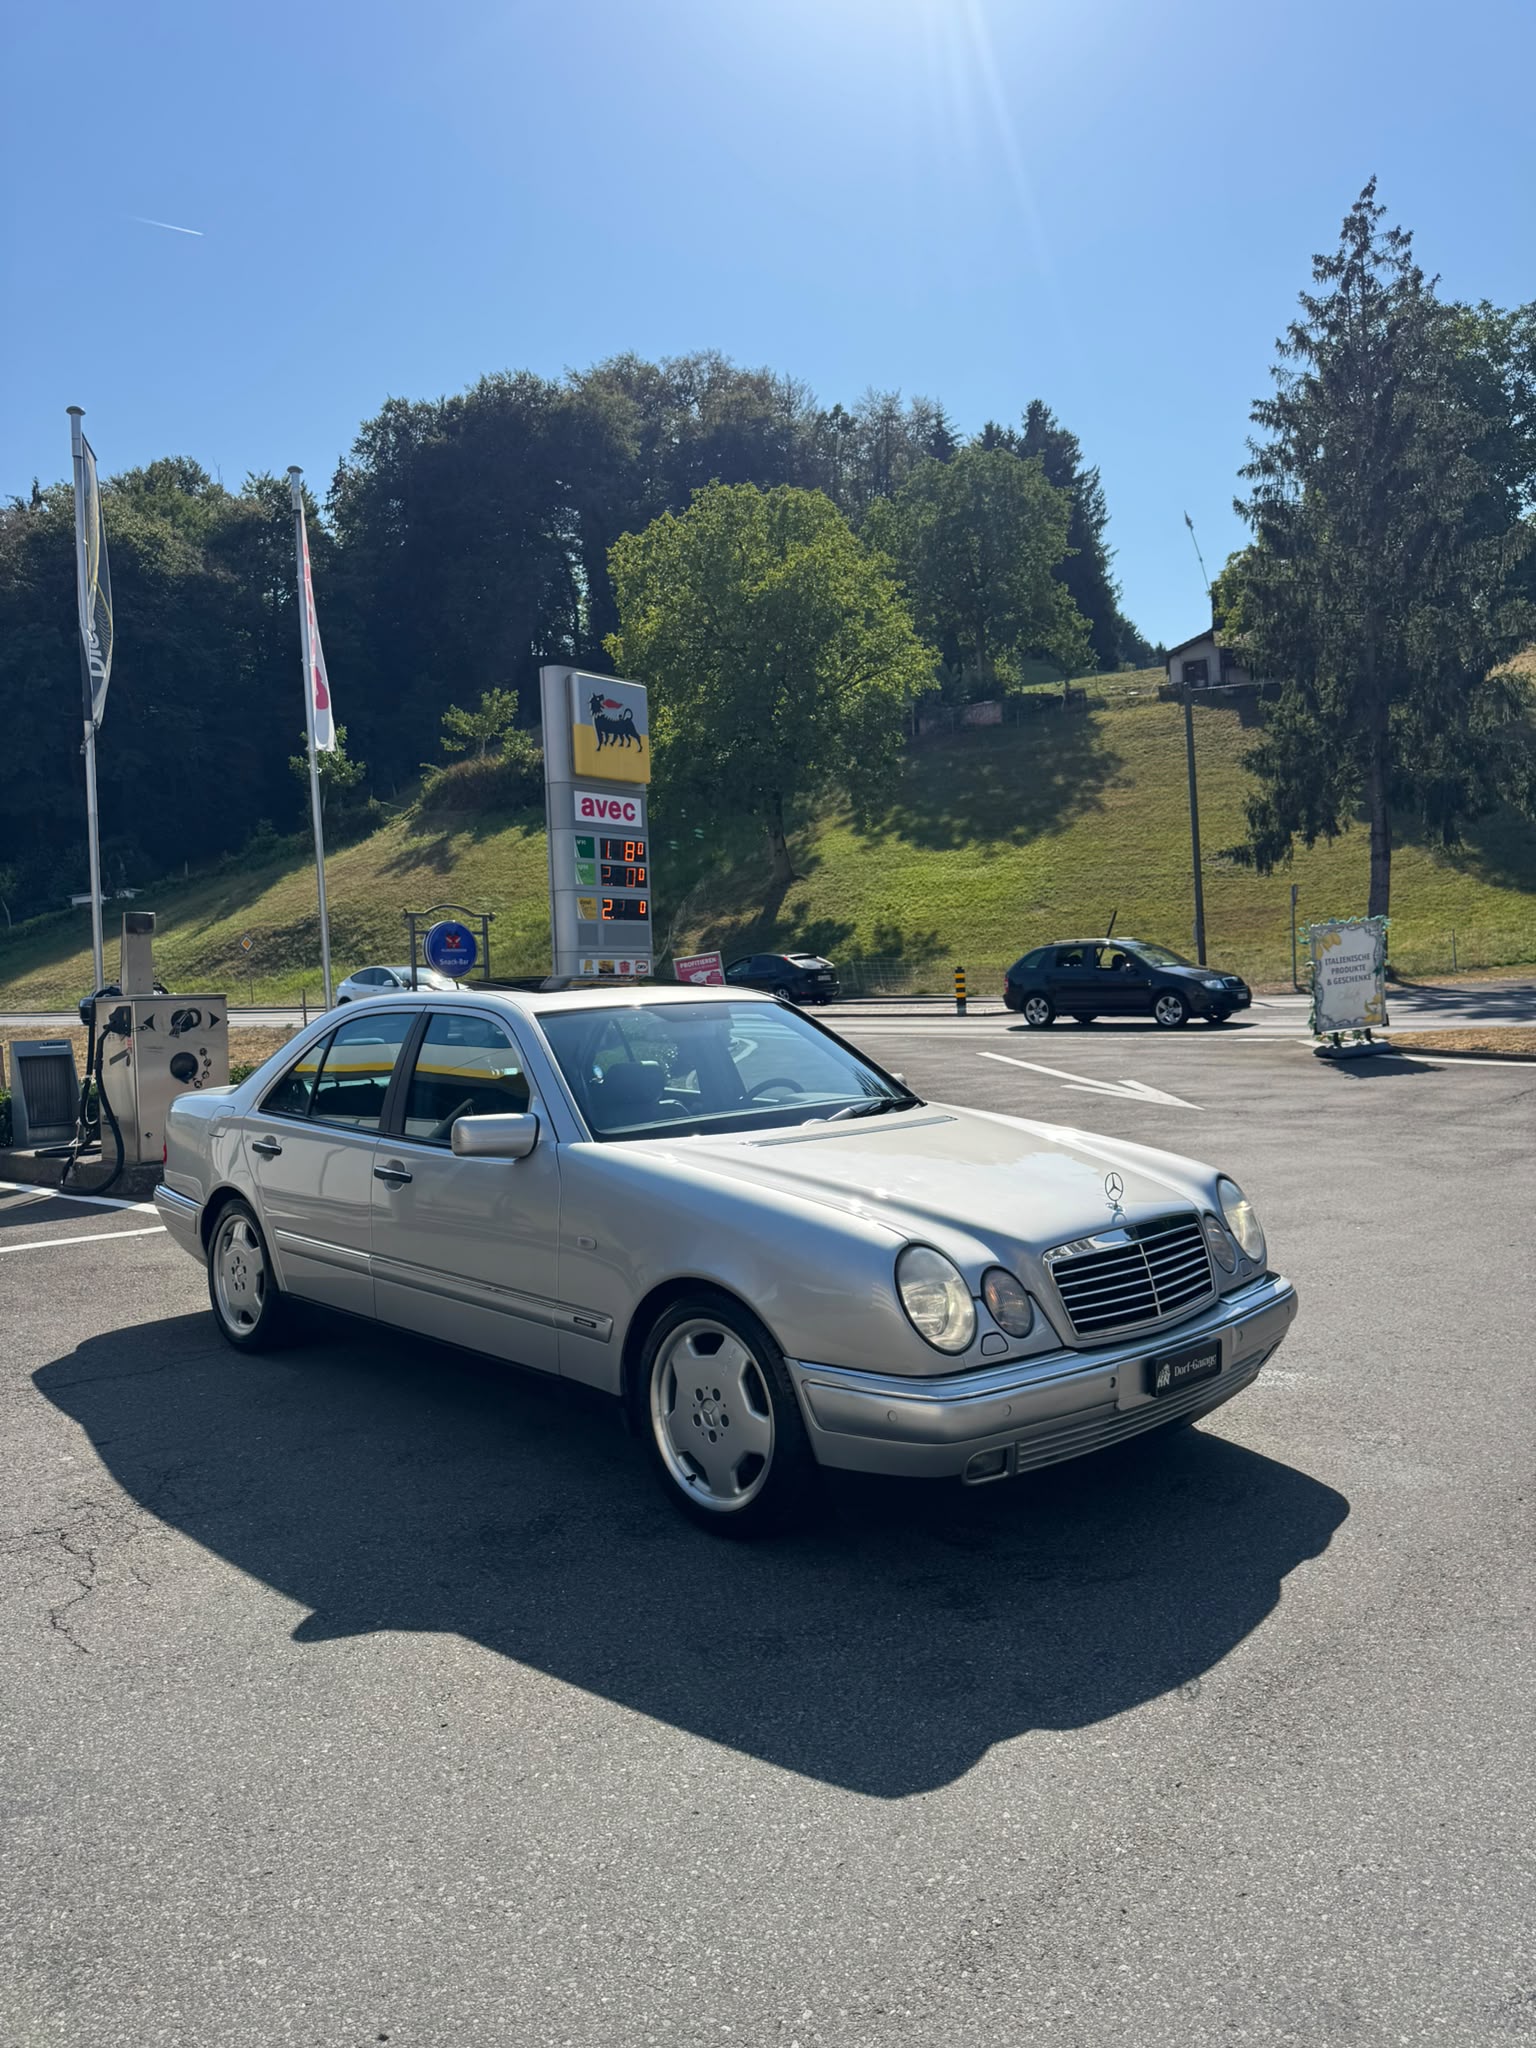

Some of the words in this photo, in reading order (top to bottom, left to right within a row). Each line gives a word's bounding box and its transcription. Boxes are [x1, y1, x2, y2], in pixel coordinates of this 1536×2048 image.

[581, 797, 636, 822] avec
[1325, 953, 1370, 965] ITALIENISCHE
[1331, 965, 1366, 974] PRODUKTE
[1333, 974, 1371, 984] GESCHENKE
